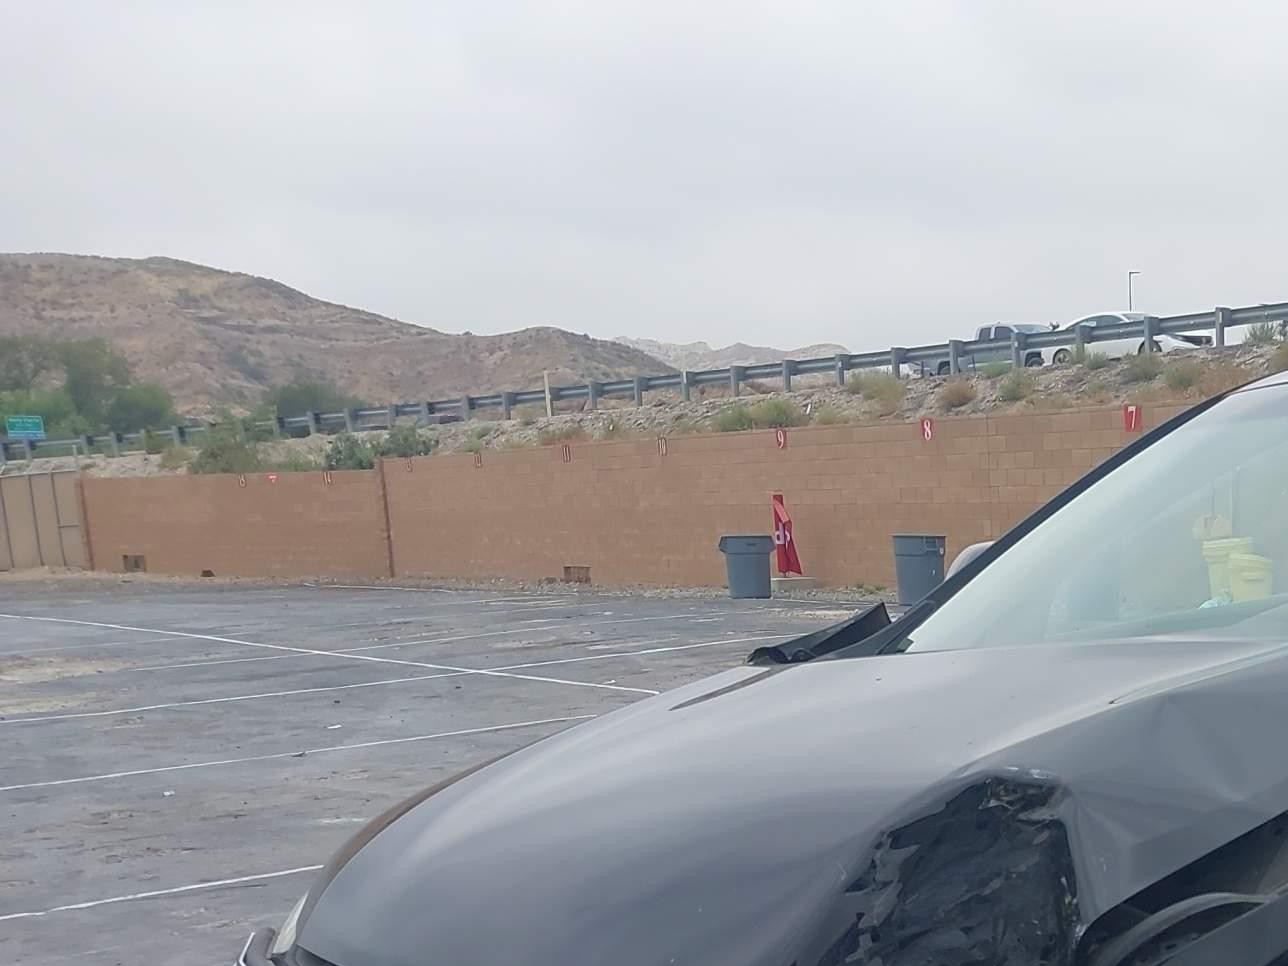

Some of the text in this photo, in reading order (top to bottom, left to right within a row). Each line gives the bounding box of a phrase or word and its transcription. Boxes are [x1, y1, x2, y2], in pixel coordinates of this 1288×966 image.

[1127, 405, 1137, 430] 7
[777, 430, 784, 449] 9
[924, 419, 931, 440] 8
